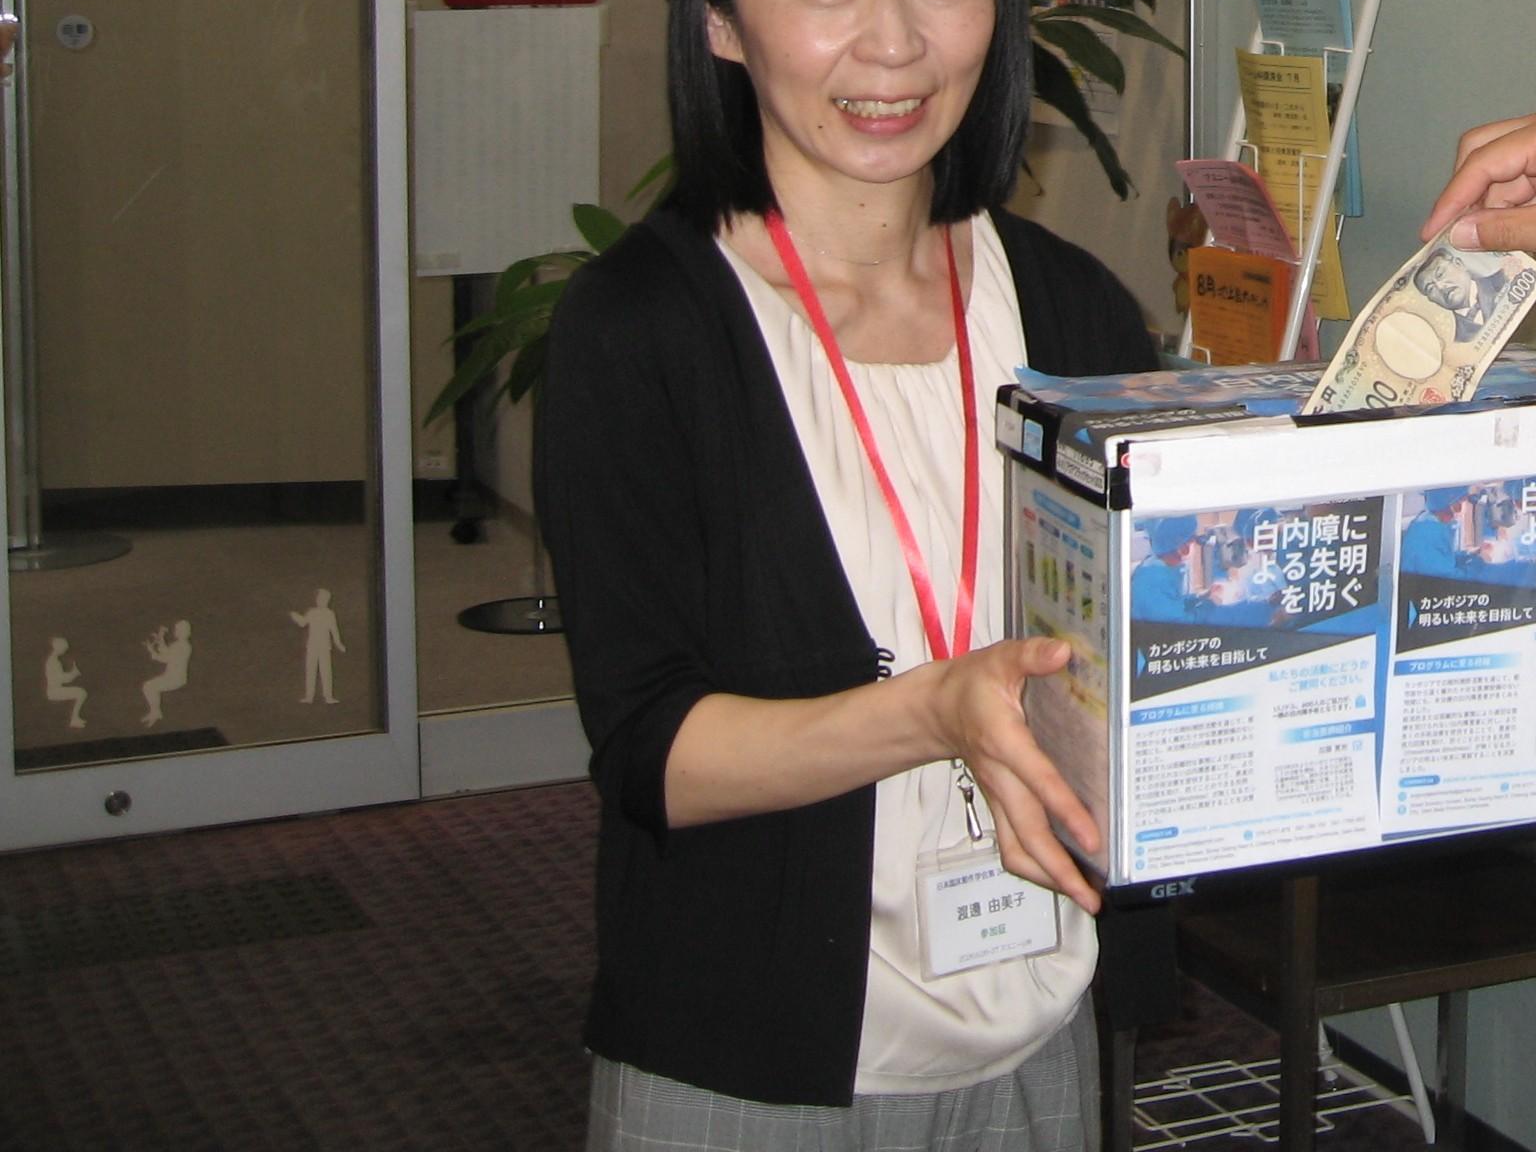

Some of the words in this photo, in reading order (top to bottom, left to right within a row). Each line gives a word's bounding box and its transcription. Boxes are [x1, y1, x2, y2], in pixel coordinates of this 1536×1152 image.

[1252, 514, 1368, 552] 白内障に
[1253, 544, 1368, 584] よる失明
[1280, 577, 1363, 614] を防ぐ
[1420, 594, 1490, 611] カンボジアの
[1419, 607, 1534, 627] 明るい未来を目指して
[1150, 636, 1222, 657] カンボジアの
[1148, 647, 1268, 675] 明るい未来を目指して
[1150, 877, 1198, 899] GEX
[988, 891, 1026, 914] 由美子
